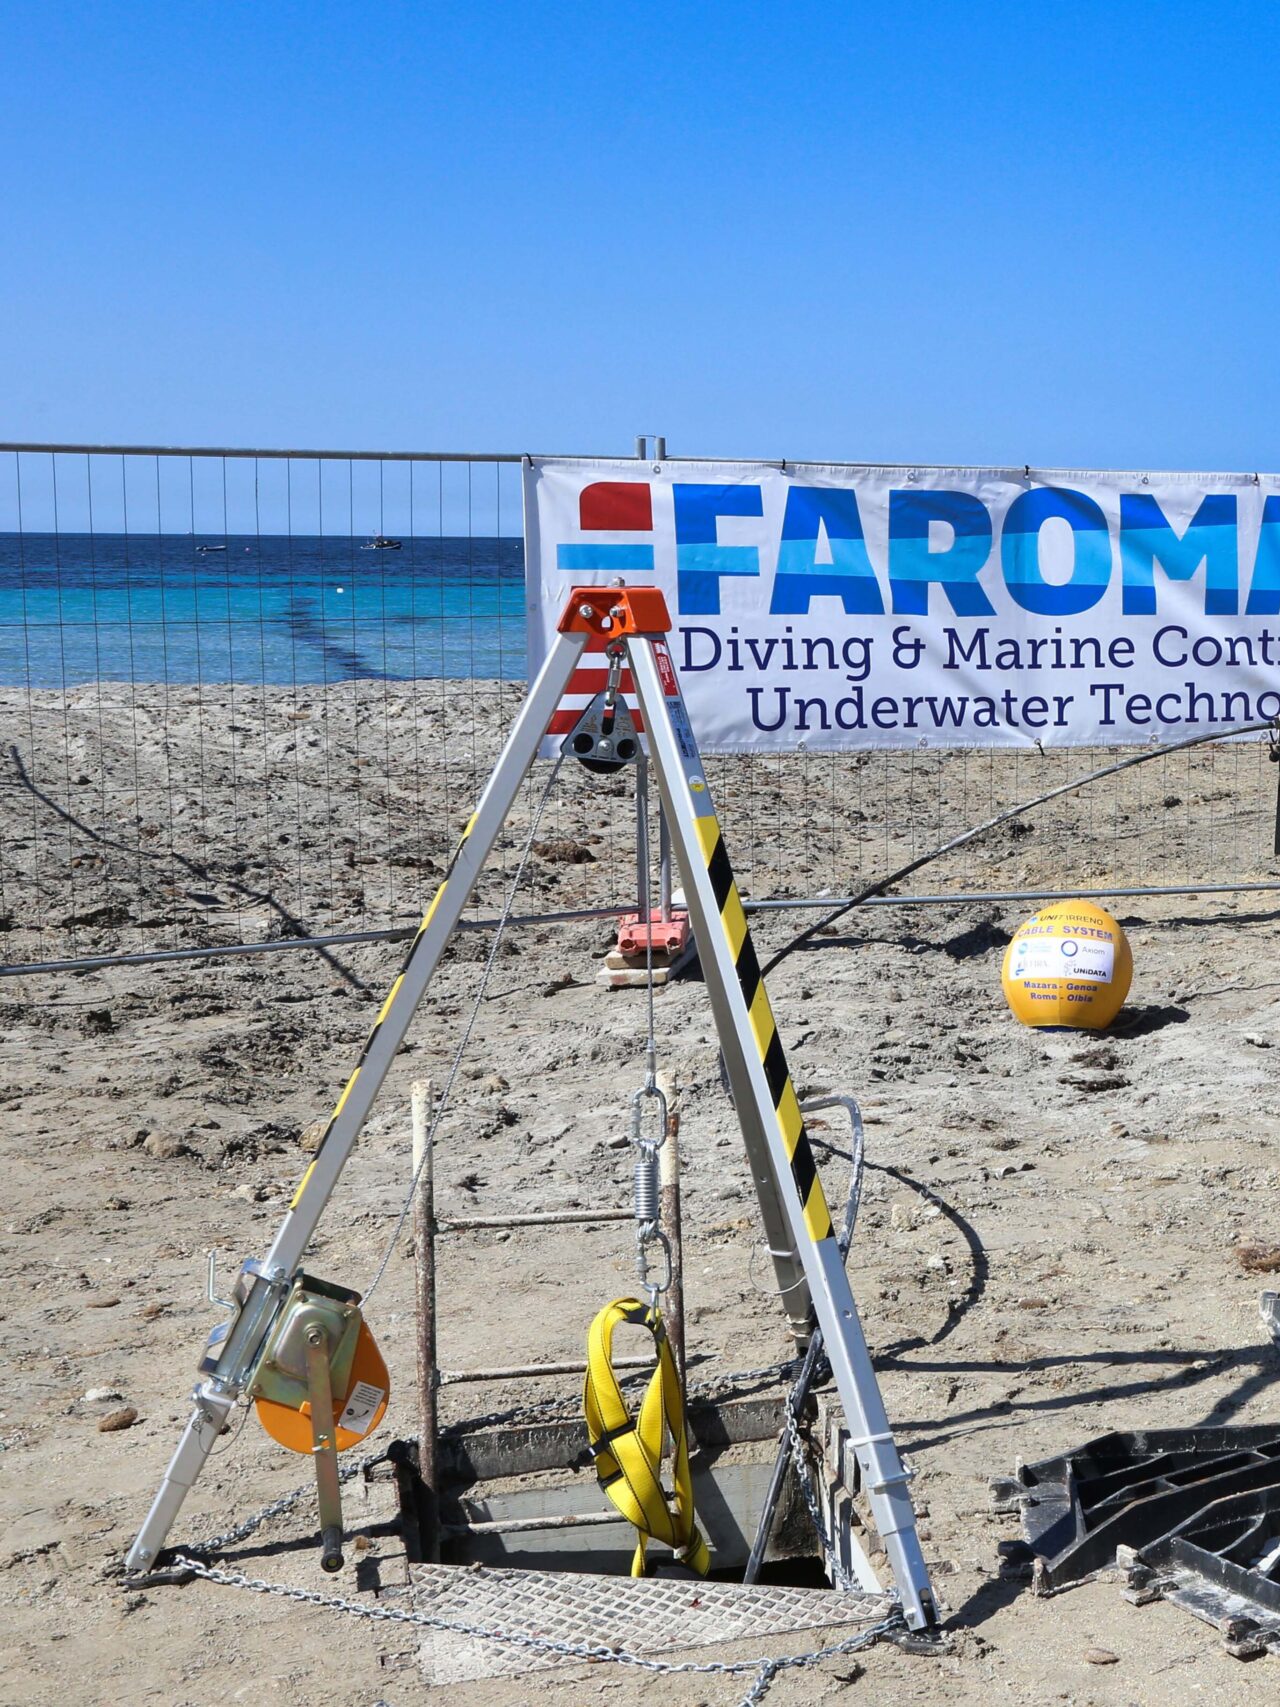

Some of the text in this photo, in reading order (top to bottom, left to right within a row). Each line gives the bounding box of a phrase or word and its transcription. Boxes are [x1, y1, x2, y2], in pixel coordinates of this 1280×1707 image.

[679, 626, 873, 681] Diving
[891, 626, 926, 669] &
[943, 626, 1135, 670] Marine
[746, 685, 1074, 732] Underwater
[1018, 925, 1113, 940] CABLE SYSTEM
[1082, 946, 1106, 956] Axiom
[1023, 981, 1058, 989] Mazara
[1030, 992, 1058, 1001] Rome
